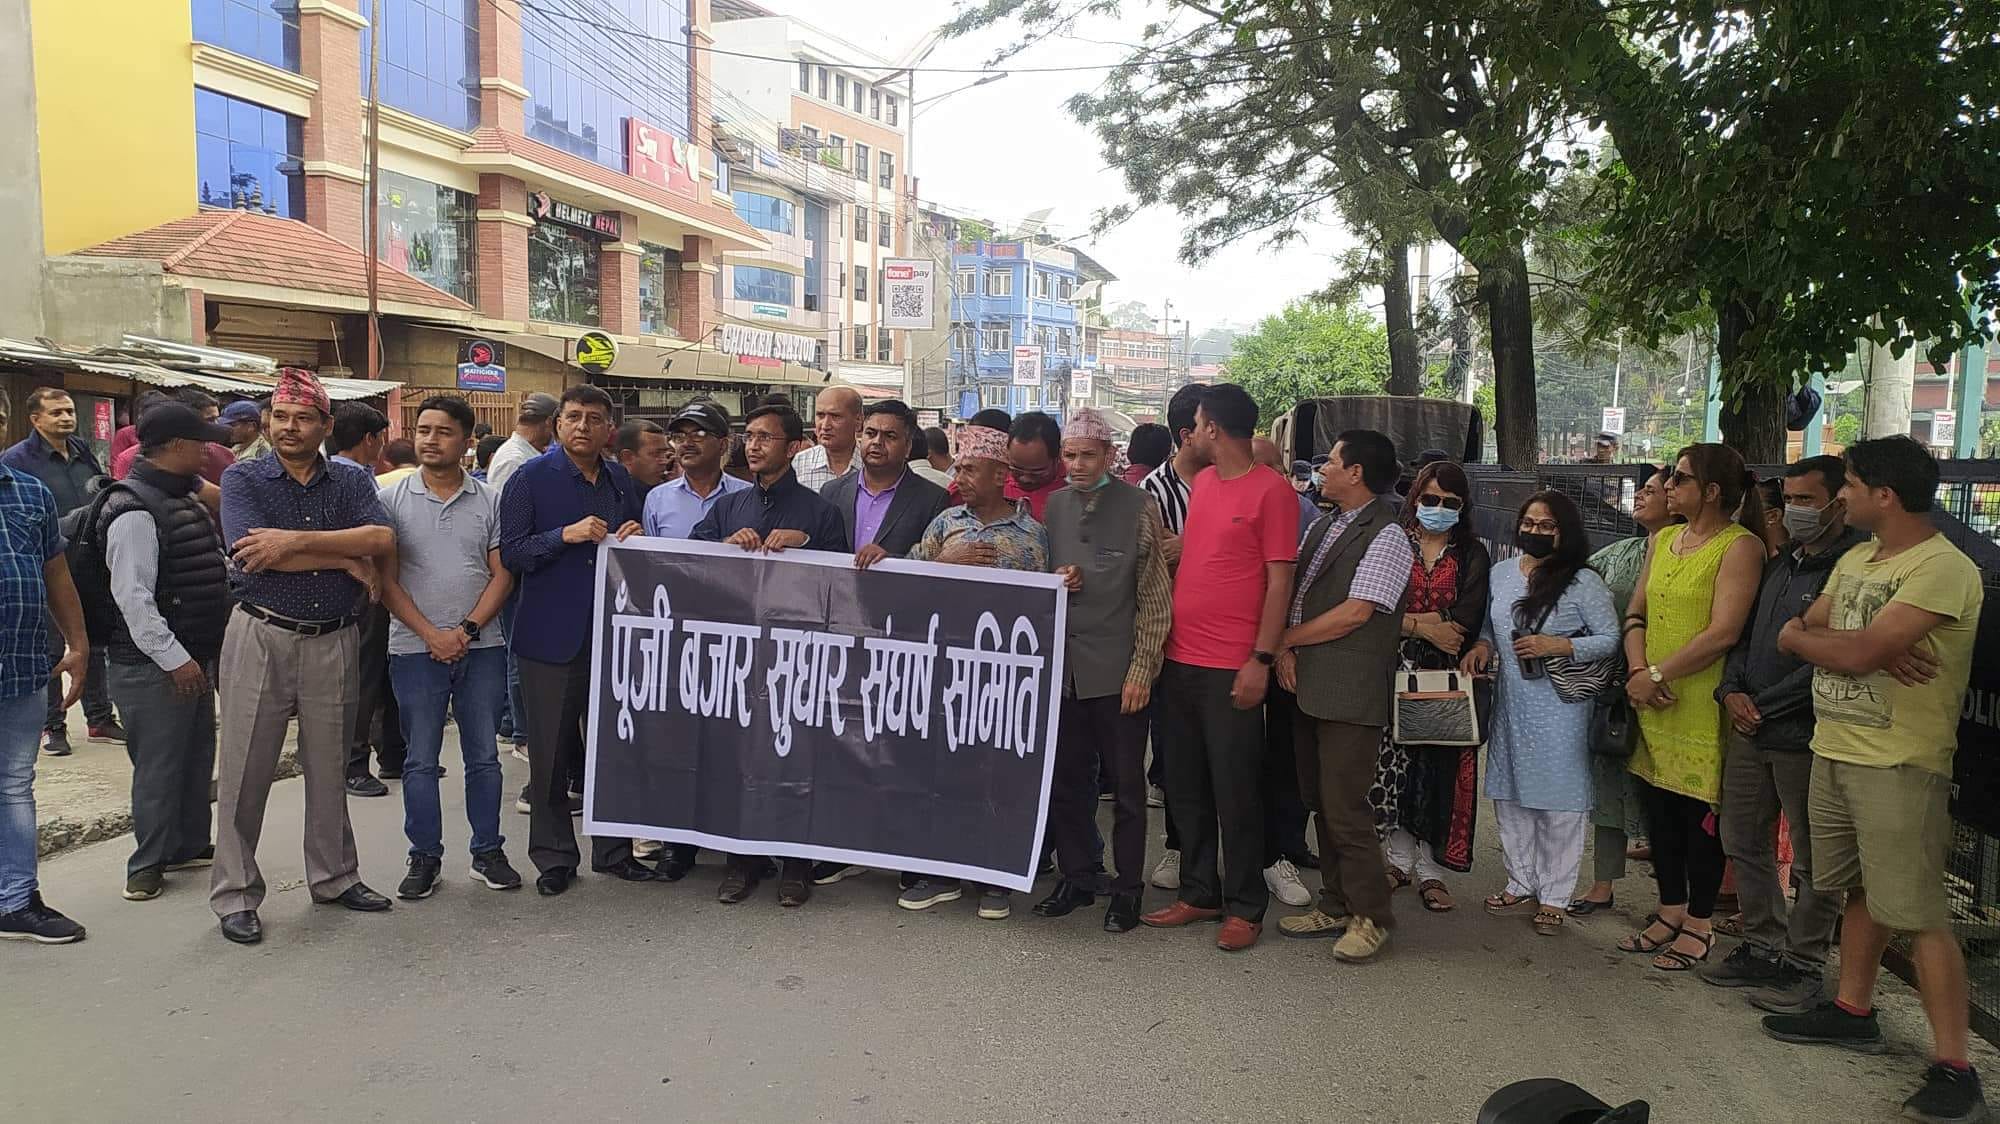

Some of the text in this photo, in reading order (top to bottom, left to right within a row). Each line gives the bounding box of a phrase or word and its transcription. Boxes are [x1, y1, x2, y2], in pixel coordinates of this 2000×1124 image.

[555, 202, 593, 227] HELMETS
[595, 213, 618, 235] NEPAL
[722, 323, 816, 363] CHICKEN STATION
[610, 579, 1045, 759] पूँजी बजार सुधार संघर्ष समिति
